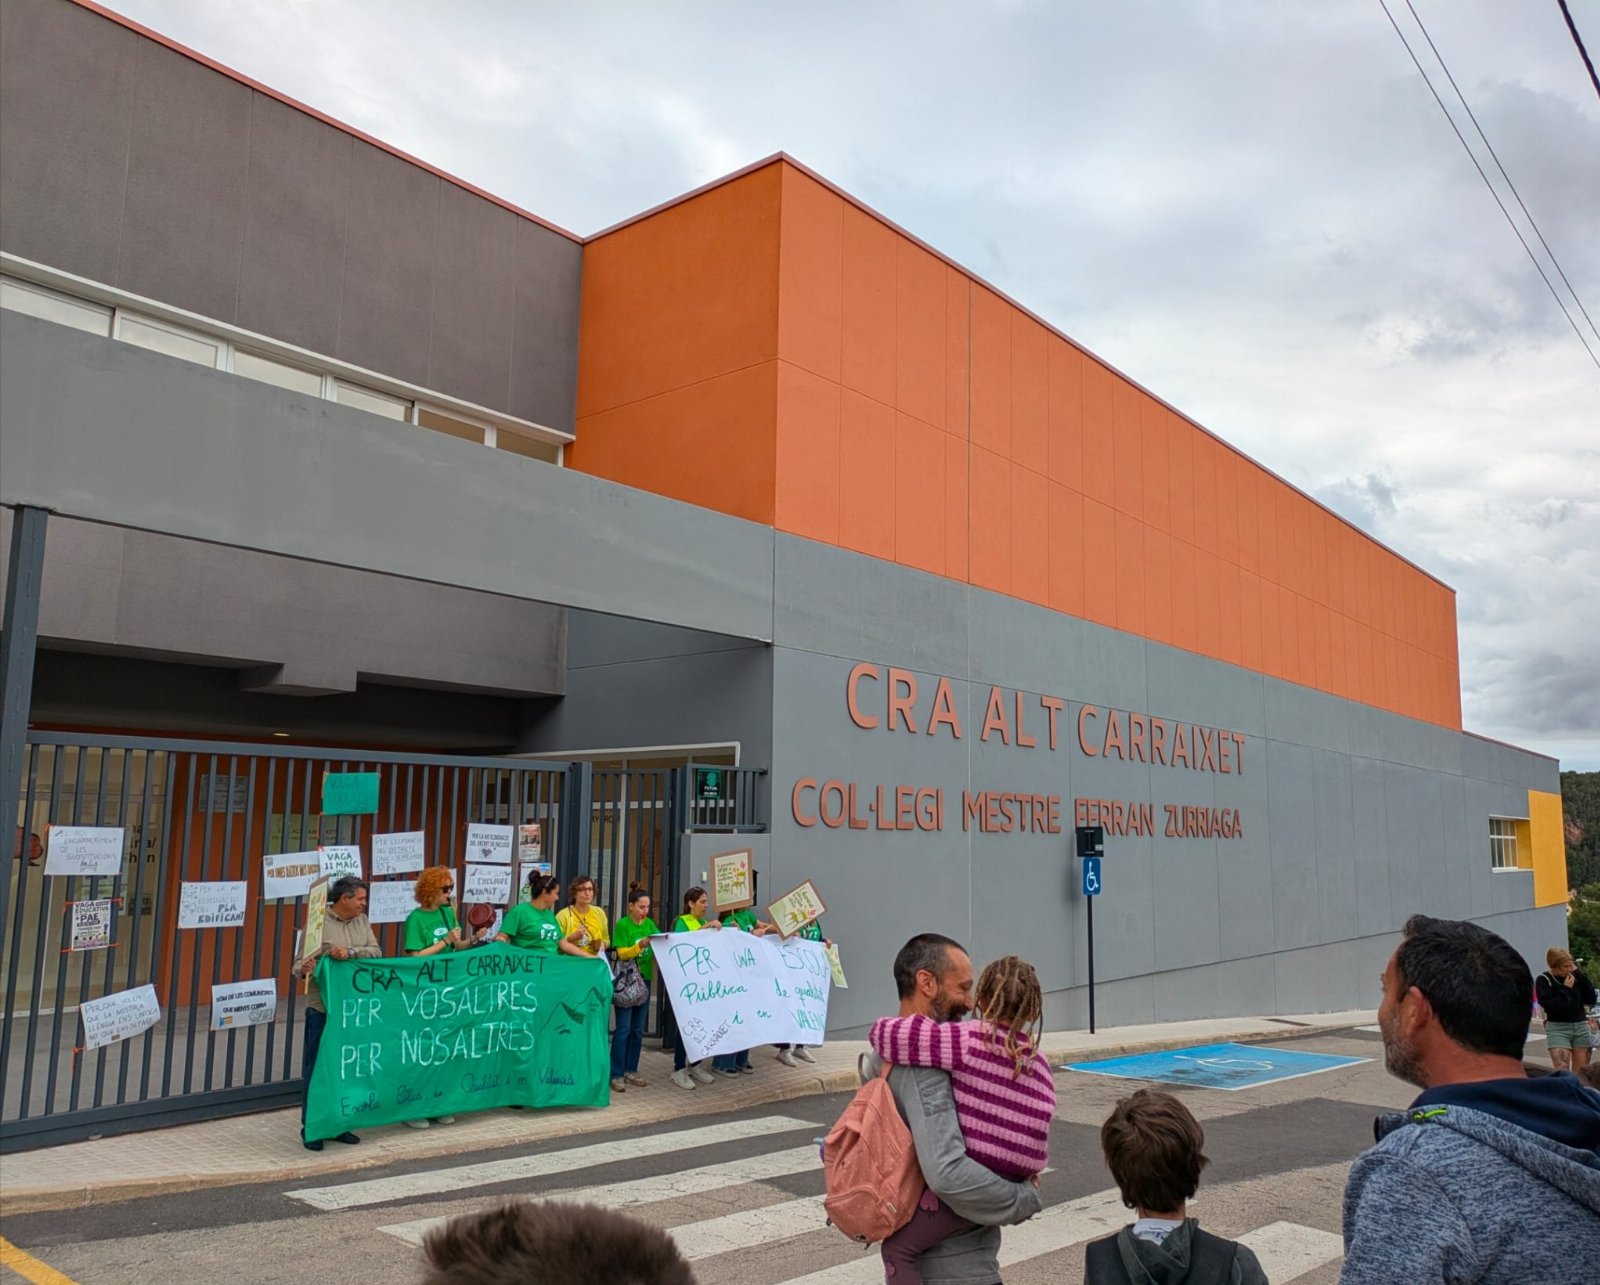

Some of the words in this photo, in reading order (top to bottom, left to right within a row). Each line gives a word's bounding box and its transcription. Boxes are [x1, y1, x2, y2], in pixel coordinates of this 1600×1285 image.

[847, 662, 961, 739] CRA
[981, 686, 1064, 750] ALT
[1078, 704, 1246, 775] CARRAIXET
[962, 790, 1061, 833] MESTRE
[1075, 798, 1154, 838] FERRAN
[1164, 804, 1243, 839] ZURRIAGA
[325, 861, 333, 870] 11
[326, 852, 353, 861] VAGA
[80, 913, 99, 922] PAE
[218, 904, 237, 913] PLA
[668, 942, 720, 977] PER
[733, 946, 757, 969] UNA
[352, 967, 404, 994] CRA
[416, 958, 454, 987] ALT
[467, 954, 548, 977] CARRAIXET
[773, 976, 791, 999] de
[342, 998, 383, 1028] PER
[402, 980, 538, 1019] VOSALTRES
[756, 1008, 772, 1019] en
[682, 1017, 704, 1036] CRA
[341, 1042, 383, 1080] PER
[402, 1021, 535, 1066] NOSALTRES
[340, 1092, 382, 1117] Escola
